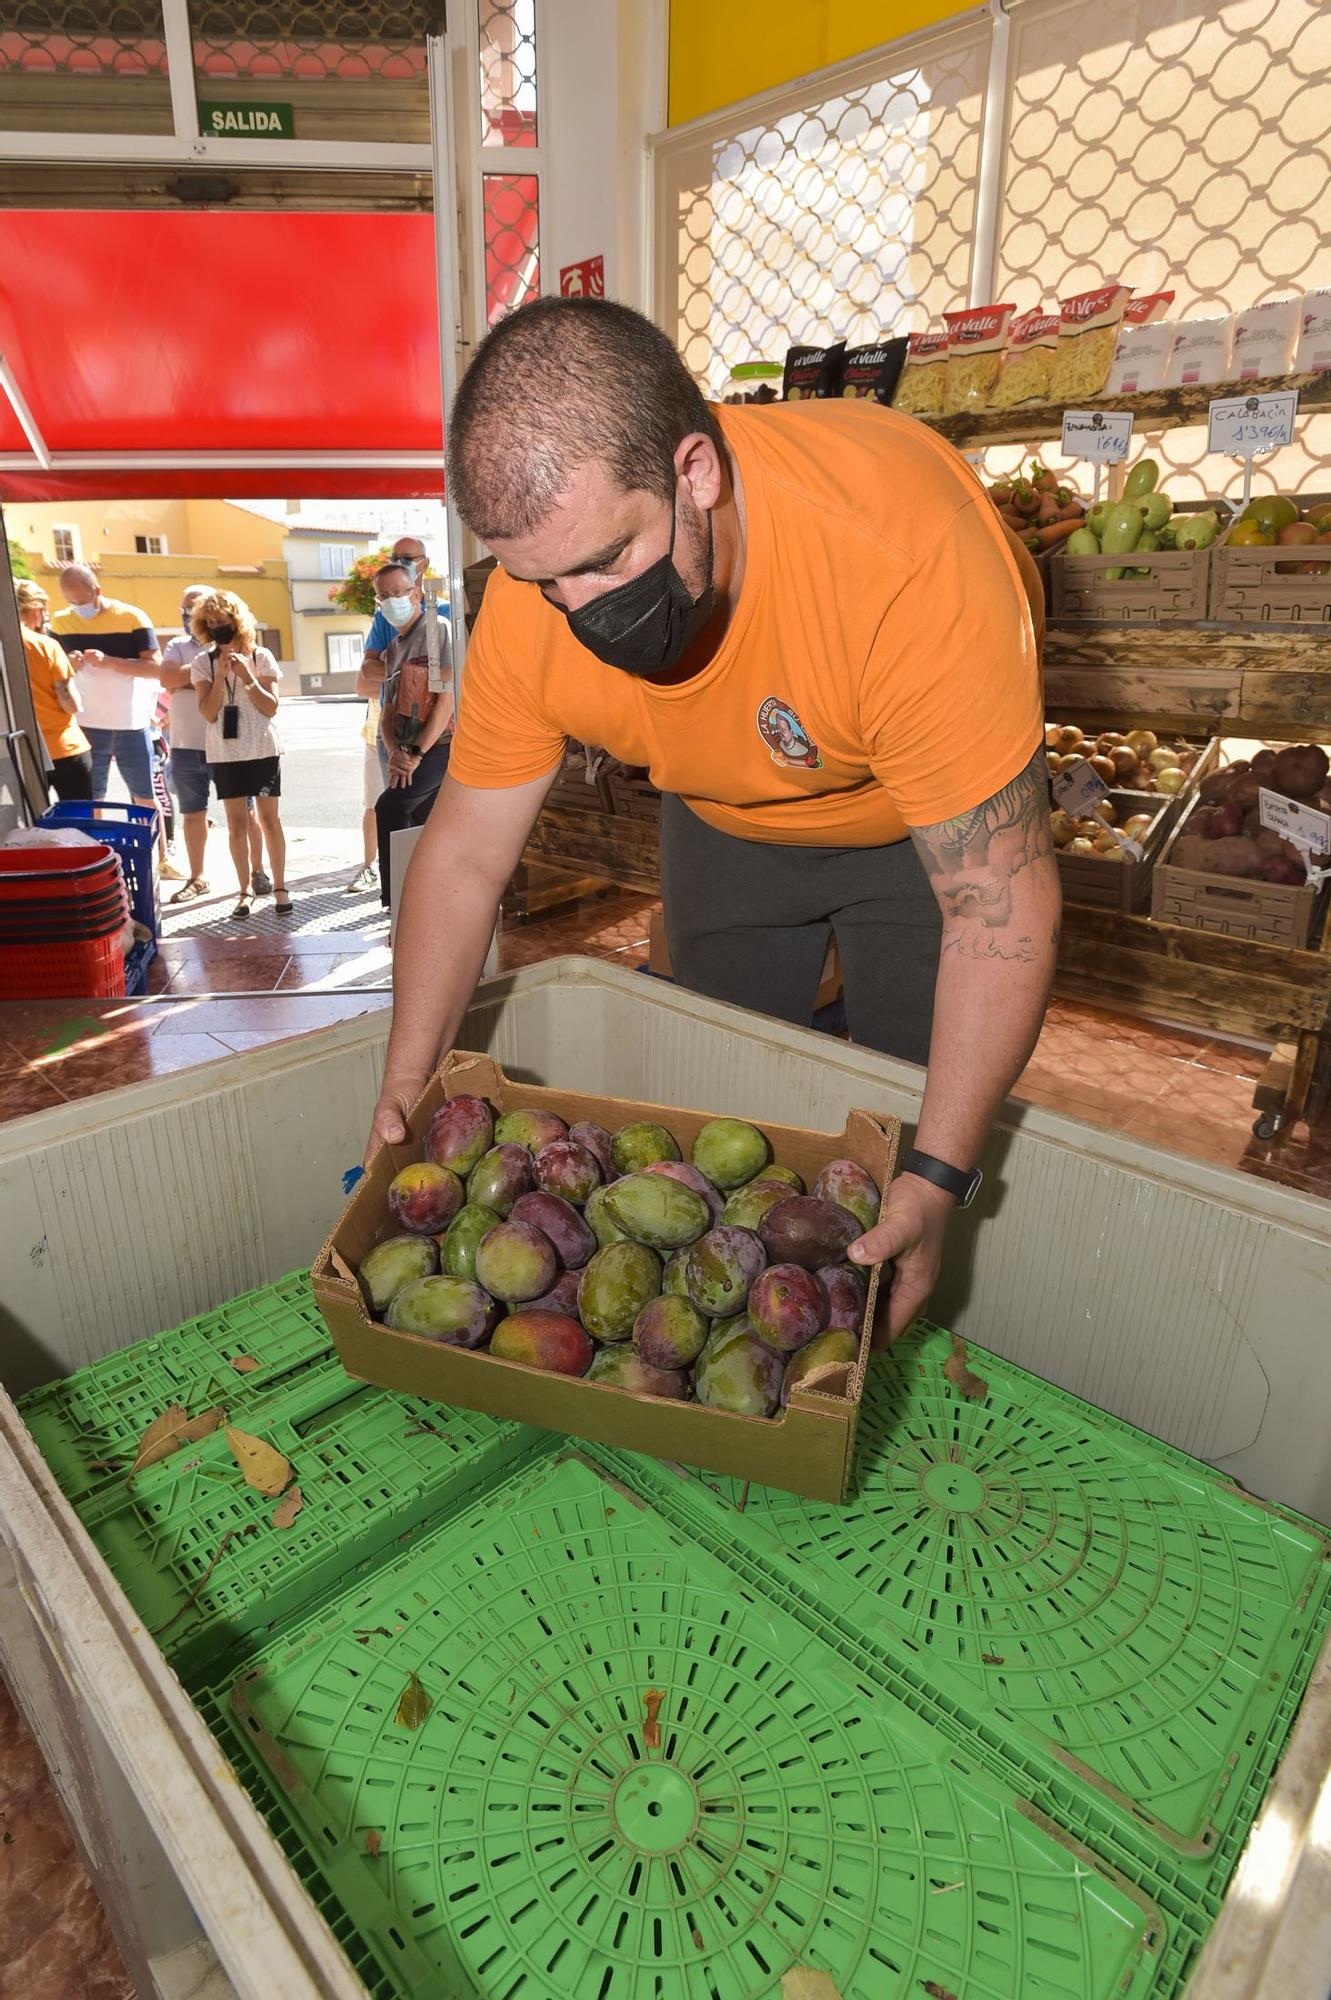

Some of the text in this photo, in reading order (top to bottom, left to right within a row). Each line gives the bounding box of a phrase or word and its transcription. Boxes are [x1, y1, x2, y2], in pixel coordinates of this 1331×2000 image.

[211, 110, 283, 131] SALIDA
[960, 316, 998, 331] Valle
[801, 351, 827, 366] Valle
[858, 350, 888, 364] Valle
